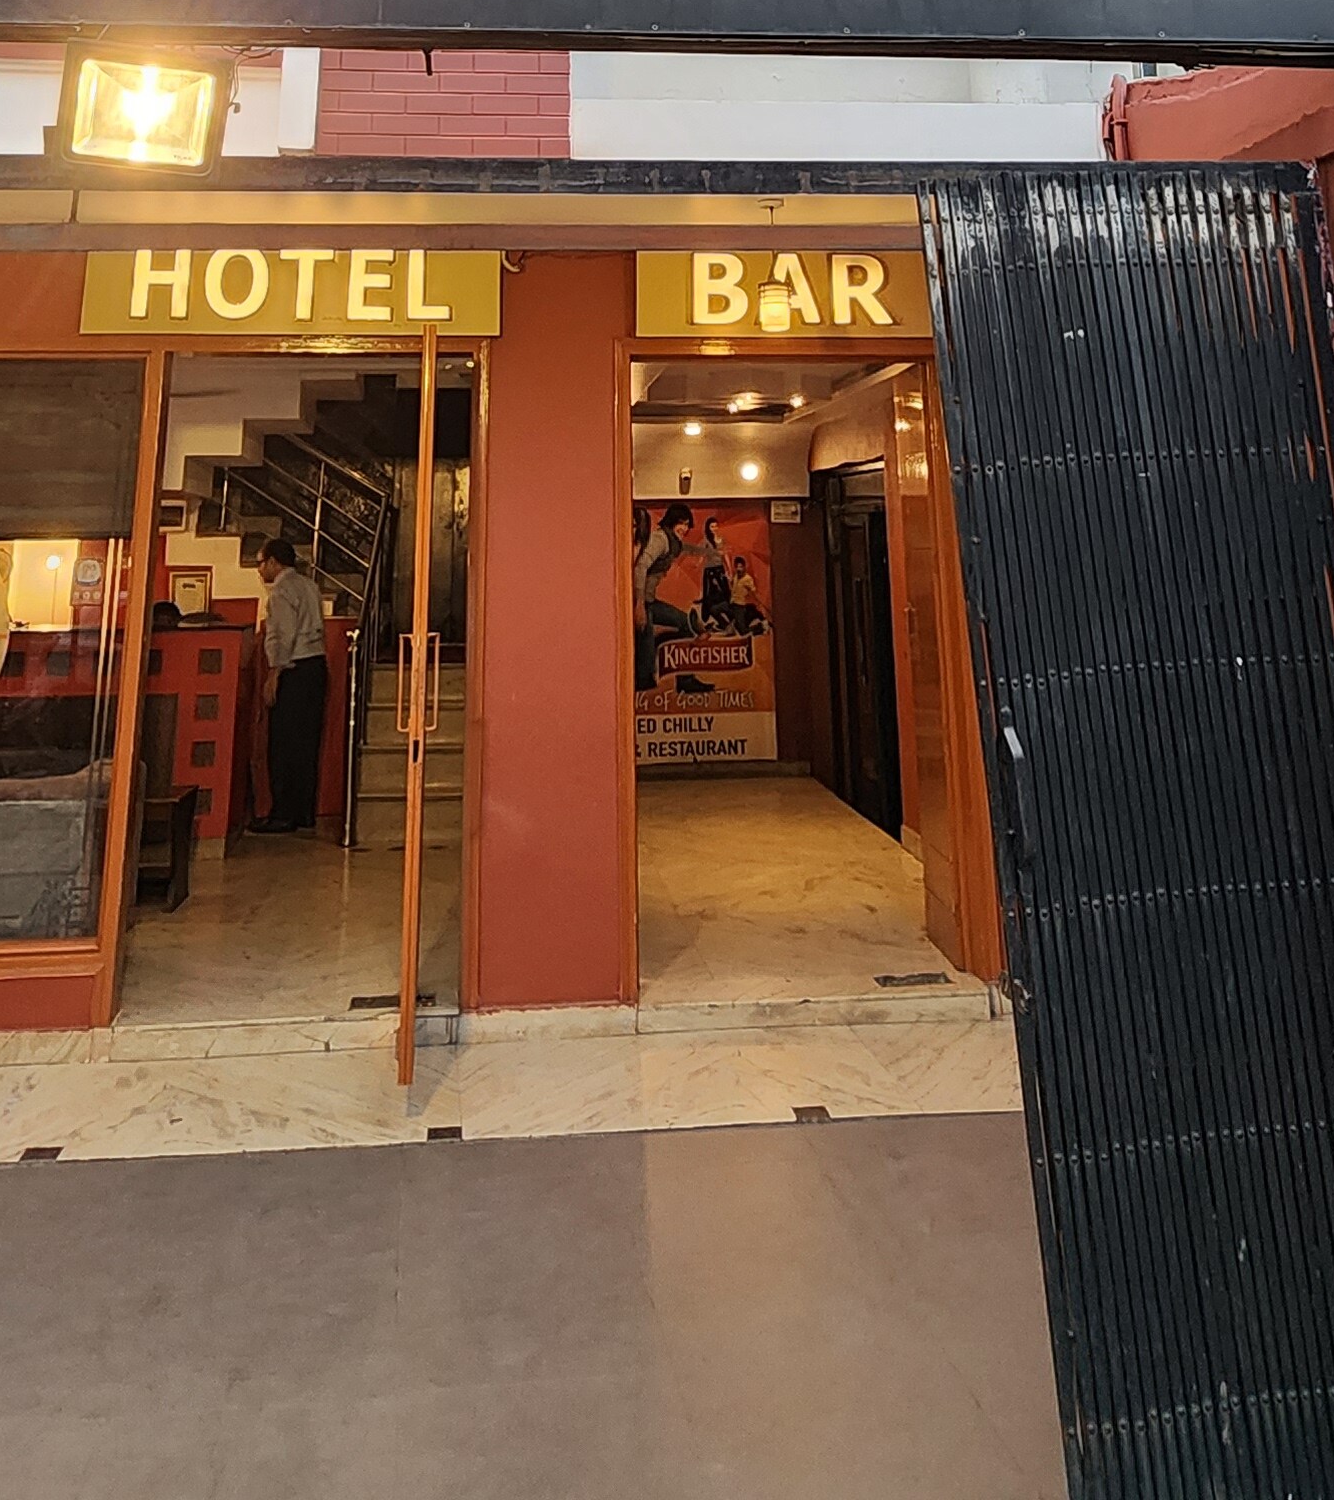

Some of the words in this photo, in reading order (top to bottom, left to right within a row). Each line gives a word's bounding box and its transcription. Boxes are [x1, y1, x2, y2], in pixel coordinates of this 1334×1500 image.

[129, 248, 453, 322] HOTEL
[663, 644, 750, 669] KINGFISHER
[637, 718, 656, 734] ED
[662, 716, 714, 733] CHILLY
[648, 738, 747, 757] RESTAURANT
